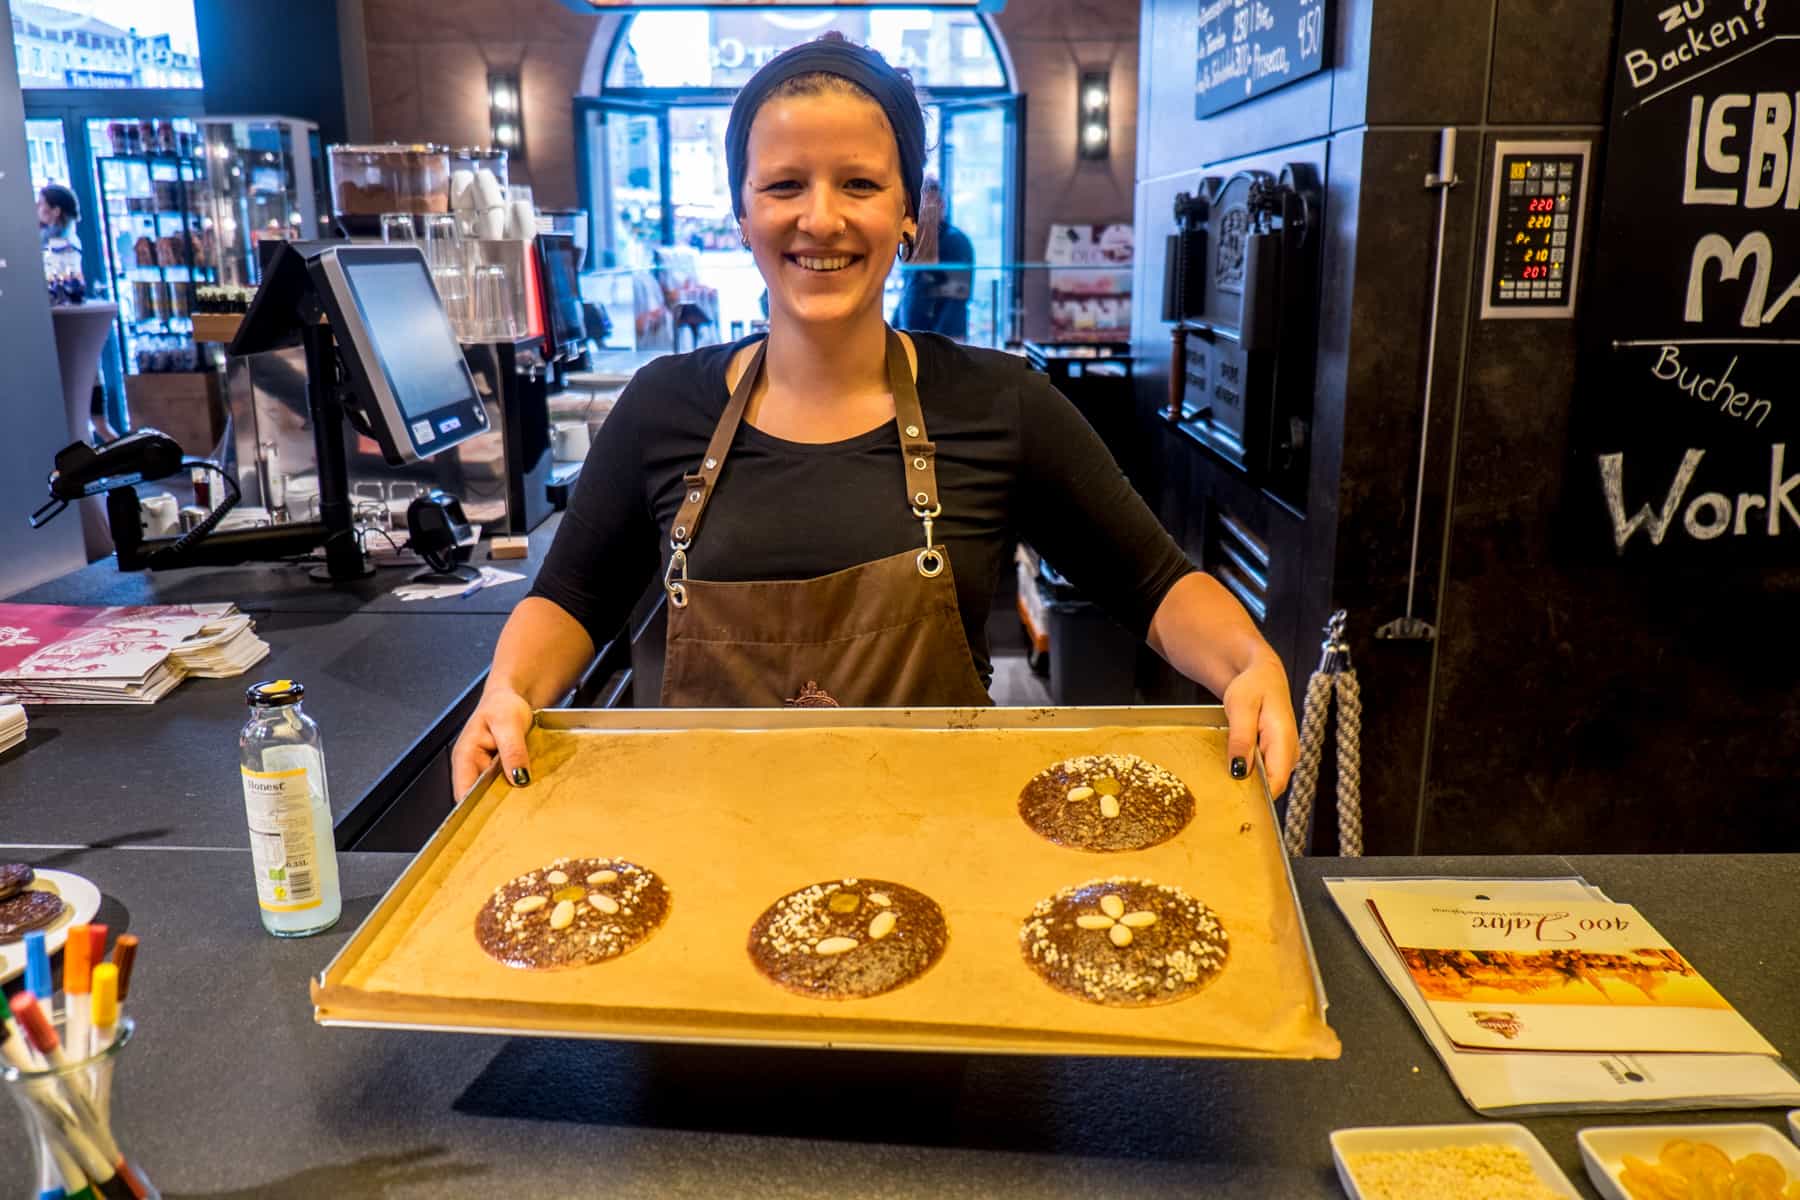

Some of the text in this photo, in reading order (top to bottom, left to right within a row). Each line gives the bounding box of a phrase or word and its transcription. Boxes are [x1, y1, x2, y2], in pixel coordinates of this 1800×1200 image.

[1529, 198, 1553, 211] 220
[1527, 215, 1551, 228] 220
[1524, 249, 1549, 262] 210
[1522, 266, 1547, 278] 207
[1651, 345, 1772, 428] Buchen
[1578, 916, 1630, 932] 400
